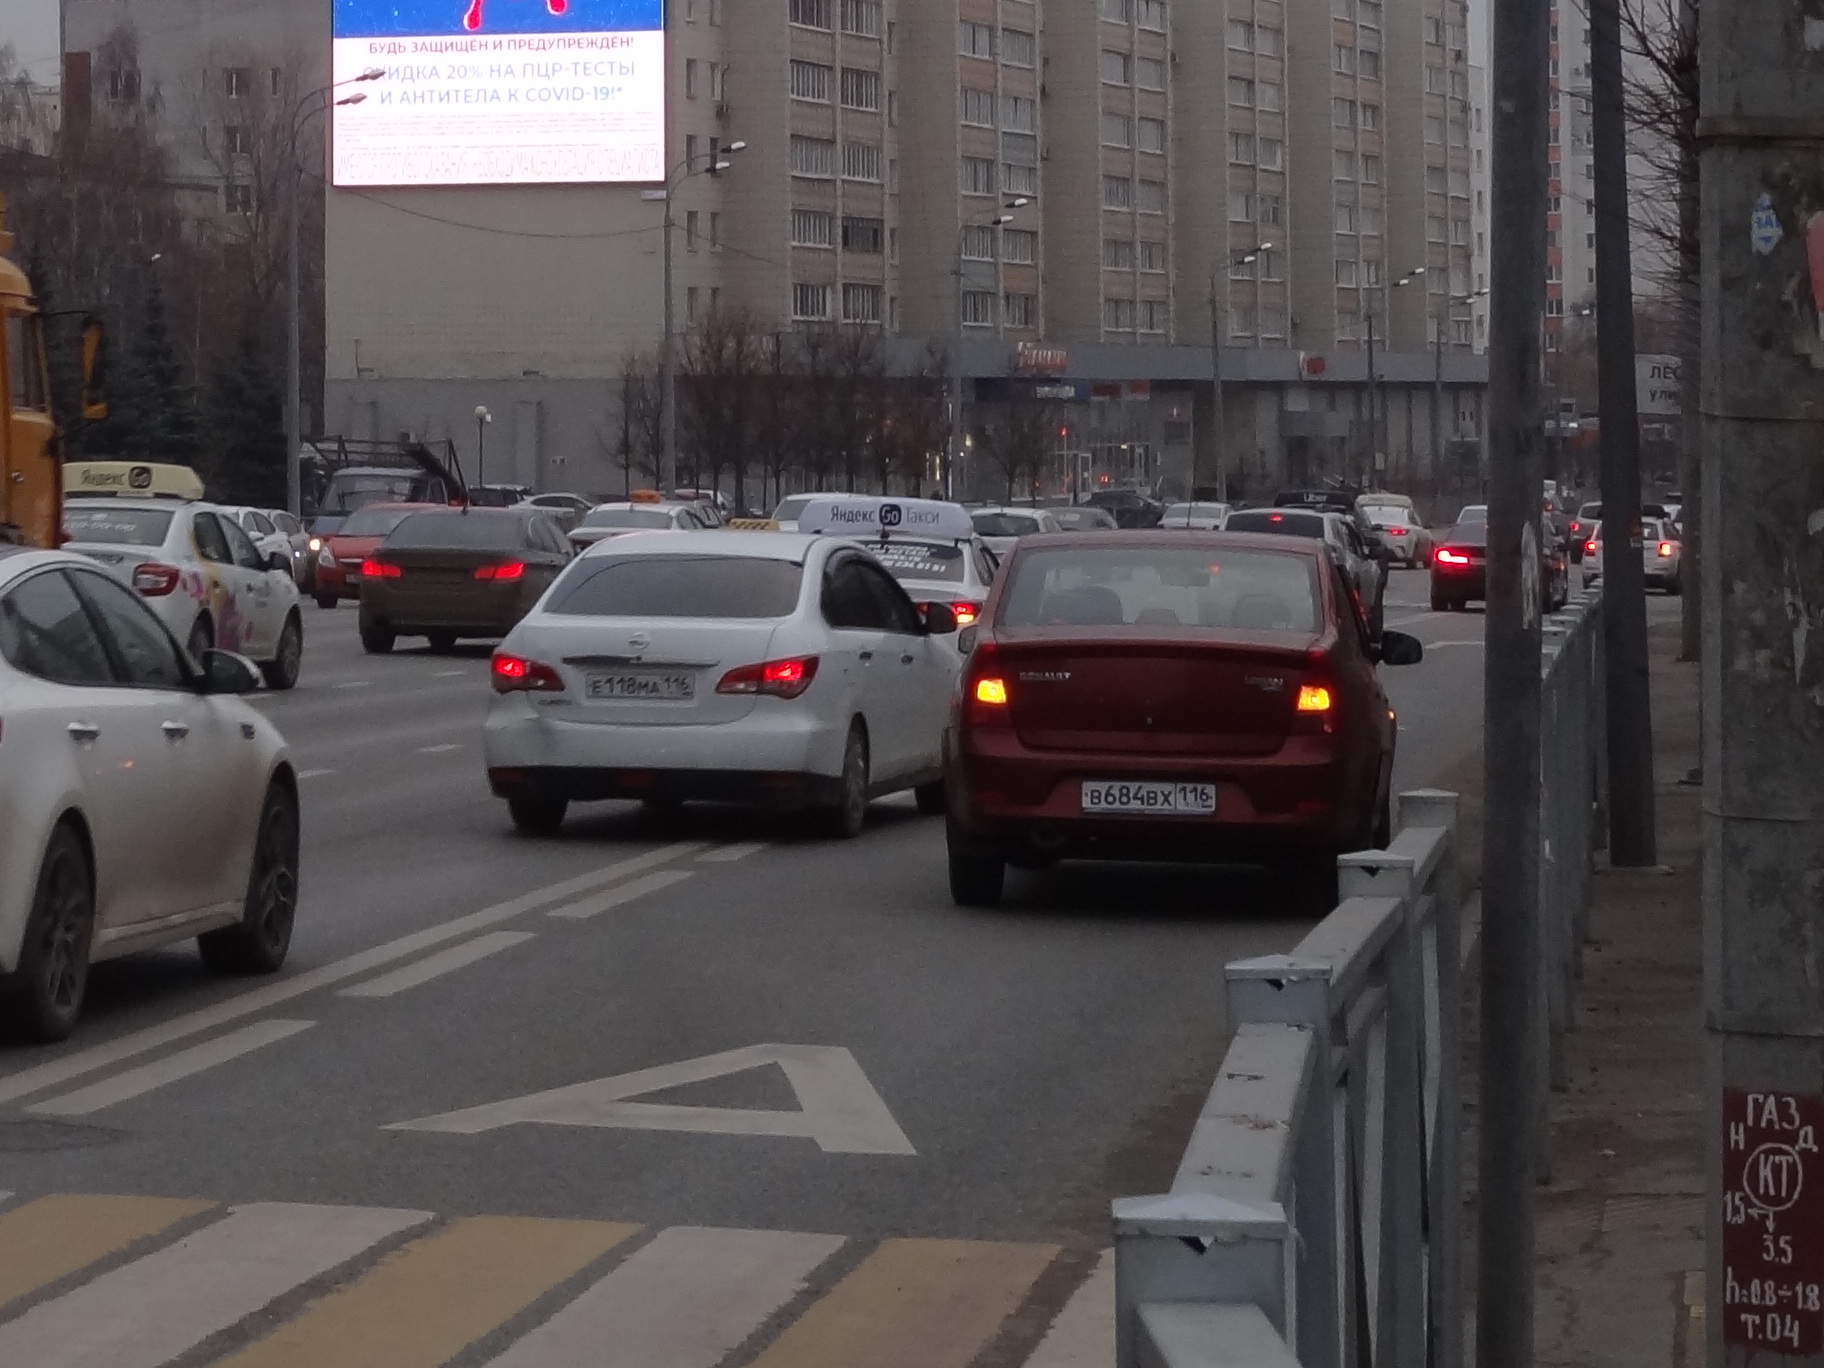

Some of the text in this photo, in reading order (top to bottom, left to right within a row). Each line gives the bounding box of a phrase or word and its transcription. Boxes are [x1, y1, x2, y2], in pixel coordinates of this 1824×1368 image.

[369, 42, 407, 55] БУДЬ
[411, 37, 488, 54] ЗАЩИЩЁН
[492, 39, 503, 51] И
[447, 64, 484, 80] 20%
[489, 63, 516, 79] НА
[522, 60, 635, 81] ПЦР-ТЕСТЫ
[380, 90, 393, 105] И
[399, 88, 502, 105] АНТИТЕЛА
[508, 87, 519, 103] К
[830, 505, 940, 524] Яндекс Go Такси
[1090, 784, 1173, 807] В684ВХ
[1747, 1093, 1800, 1130] ГАЗ
[1730, 1121, 1819, 1152] Н Д
[1759, 1153, 1794, 1198] КТ
[1762, 1234, 1793, 1264] 3.5
